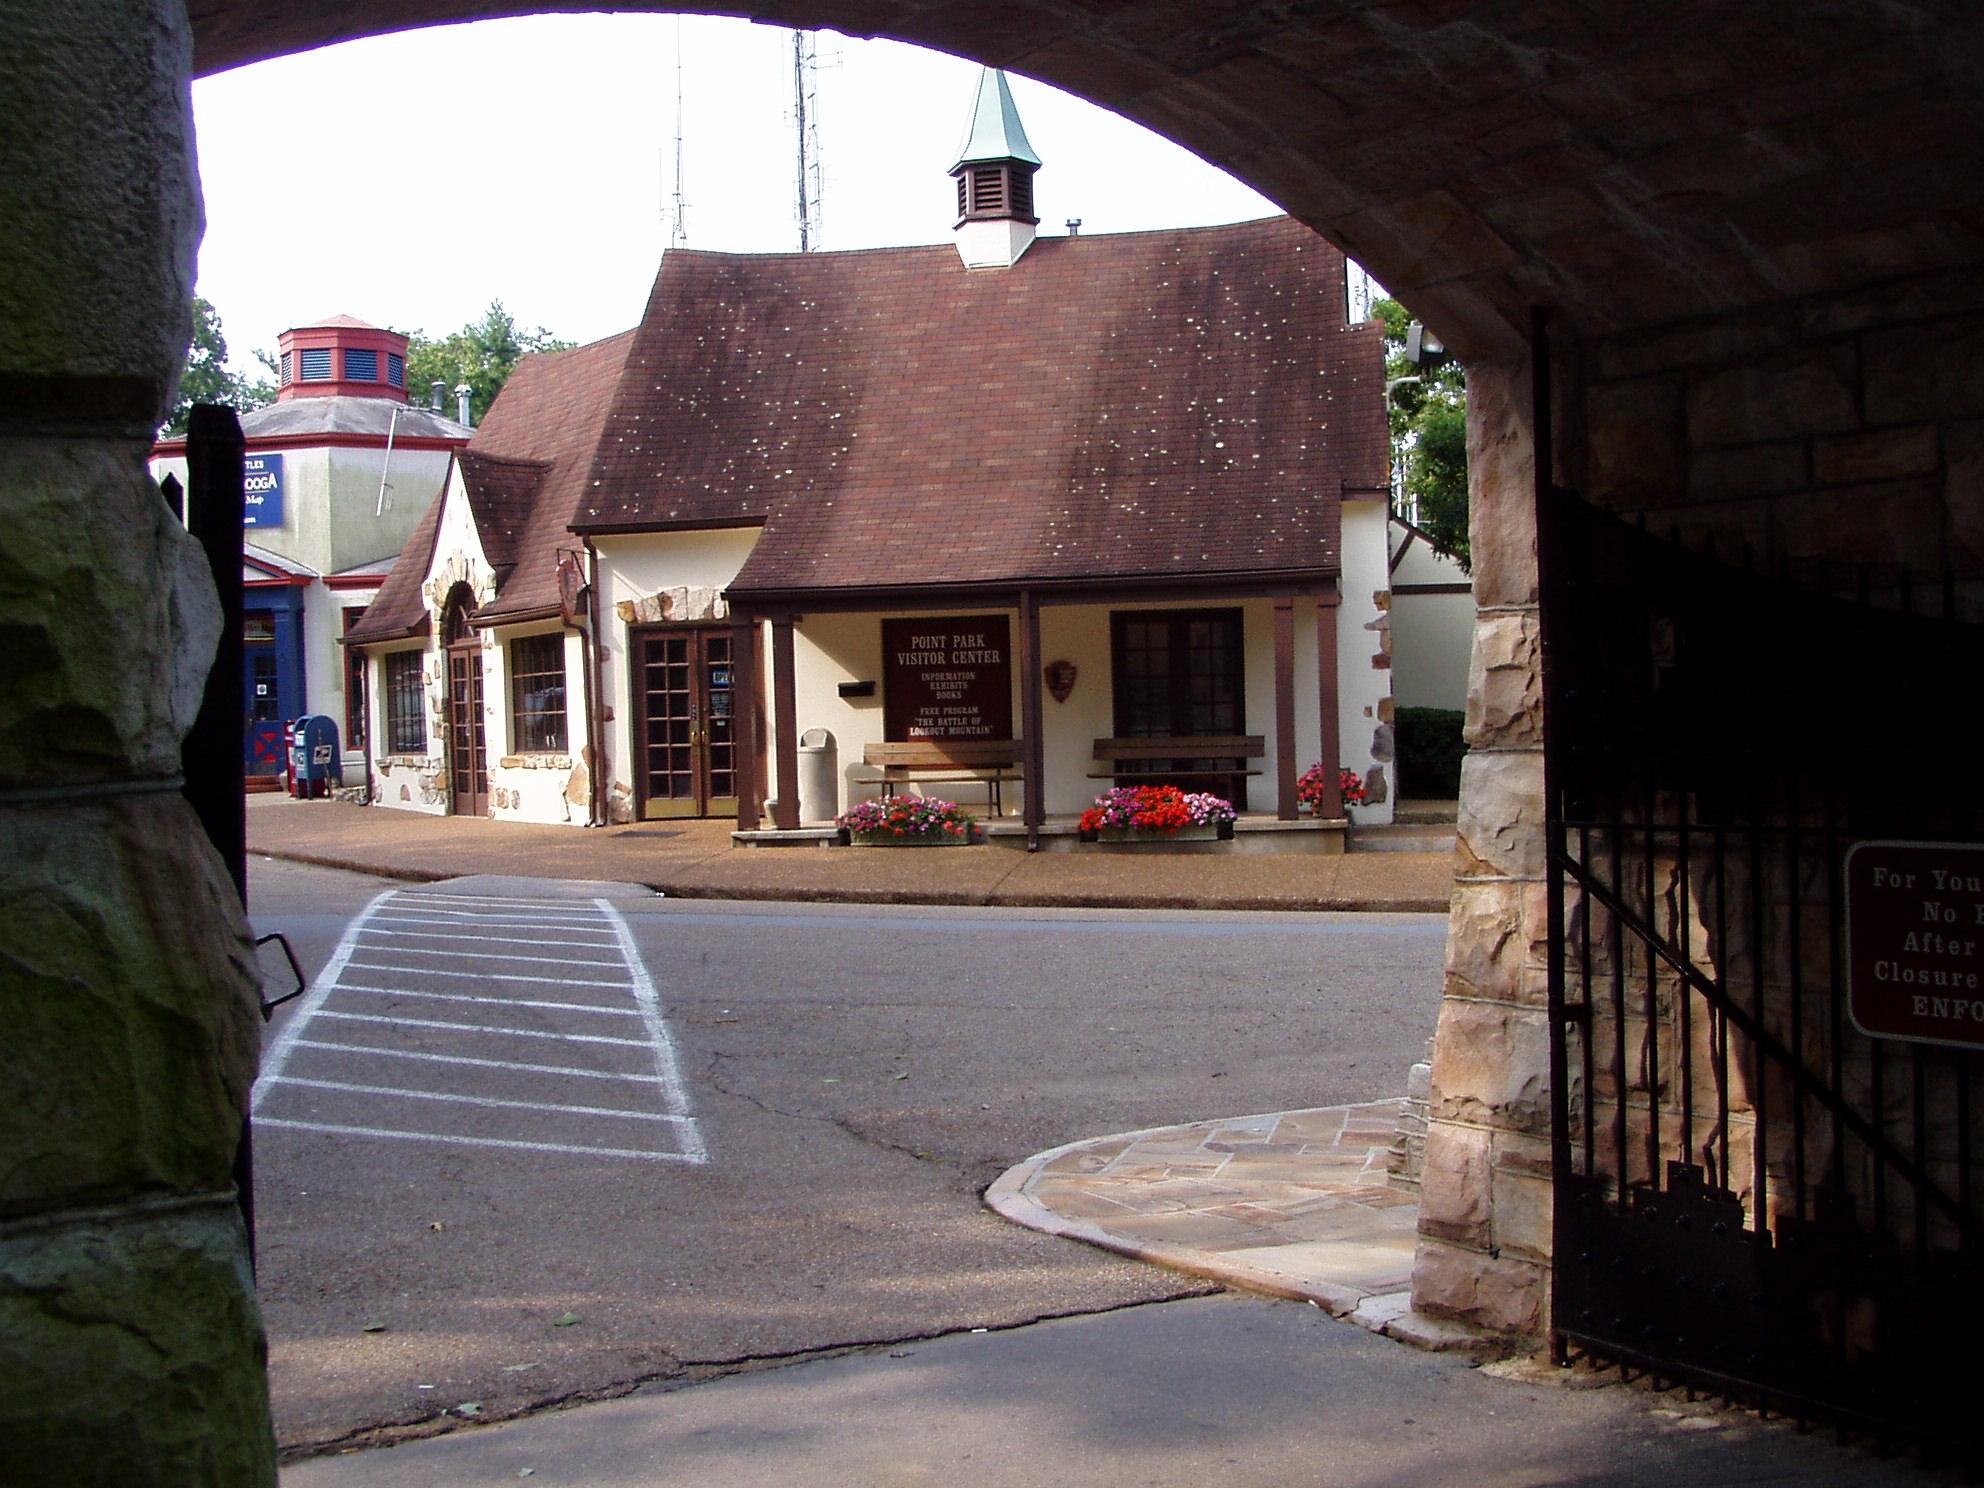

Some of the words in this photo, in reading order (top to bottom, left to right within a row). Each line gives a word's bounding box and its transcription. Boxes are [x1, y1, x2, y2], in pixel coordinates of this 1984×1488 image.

[245, 472, 278, 490] OOGA
[912, 635, 947, 649] POINT
[953, 634, 985, 648] PARK
[898, 651, 947, 665] VISITOR
[952, 650, 1000, 664] CENTER
[921, 671, 976, 681] INFORMATION
[930, 681, 968, 690] EXHIBITS
[936, 691, 962, 699] BOOKS
[920, 707, 940, 715] FREE
[943, 706, 979, 715] PROGRAM
[937, 717, 968, 726] BATTLE
[971, 716, 981, 725] OF
[910, 727, 944, 736] LOOKOUT
[1872, 867, 1916, 889] For
[1922, 901, 1956, 923] No
[1903, 931, 1976, 956] After
[1874, 960, 1978, 989] Closure
